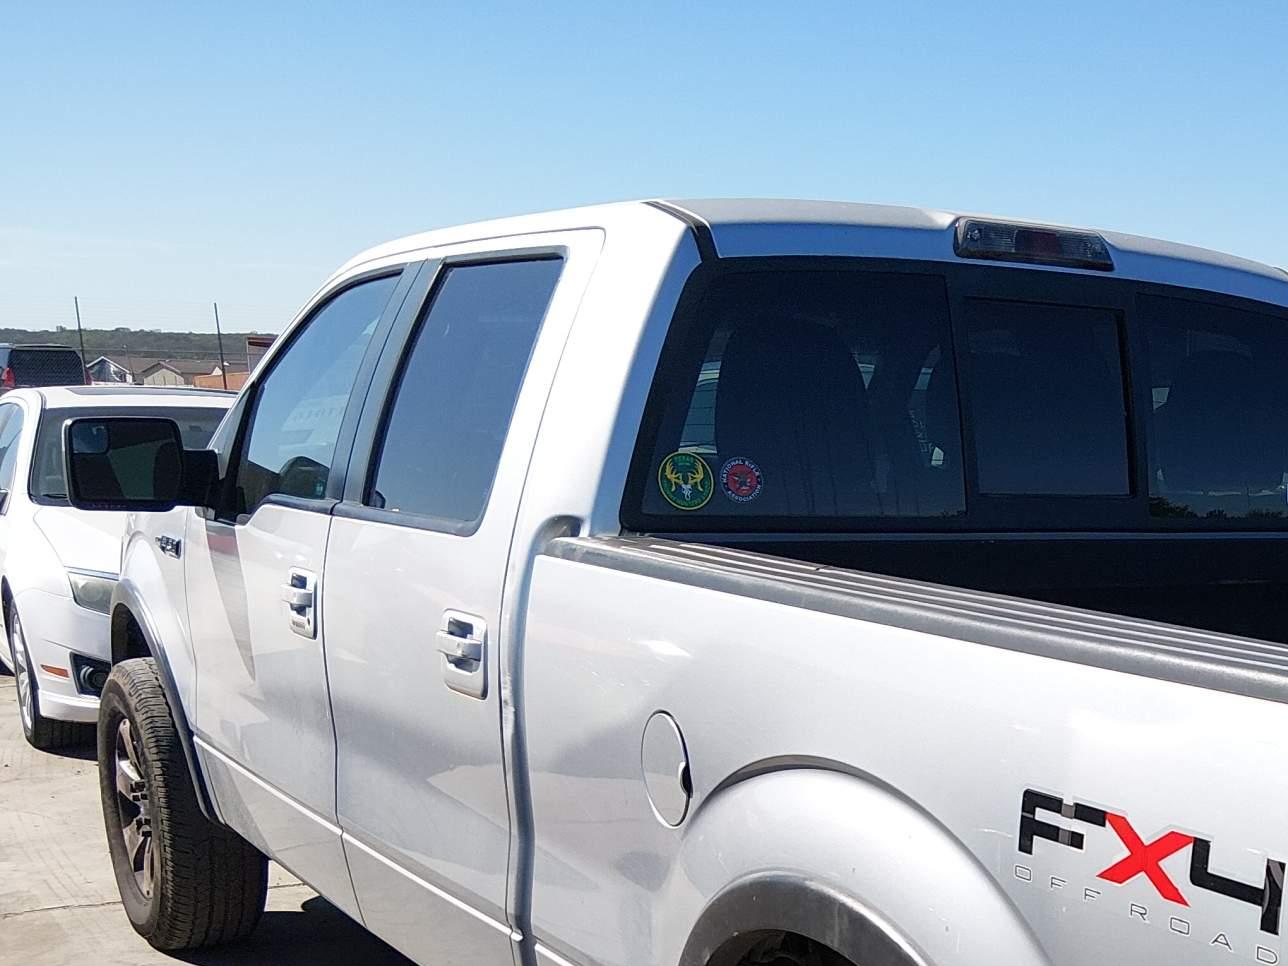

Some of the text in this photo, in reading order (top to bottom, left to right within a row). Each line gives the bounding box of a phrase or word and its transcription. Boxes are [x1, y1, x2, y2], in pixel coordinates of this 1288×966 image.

[722, 460, 761, 483] NATIONAL RIFLE
[1017, 787, 1287, 936] FX4
[1014, 864, 1280, 965] OFF ROAD
